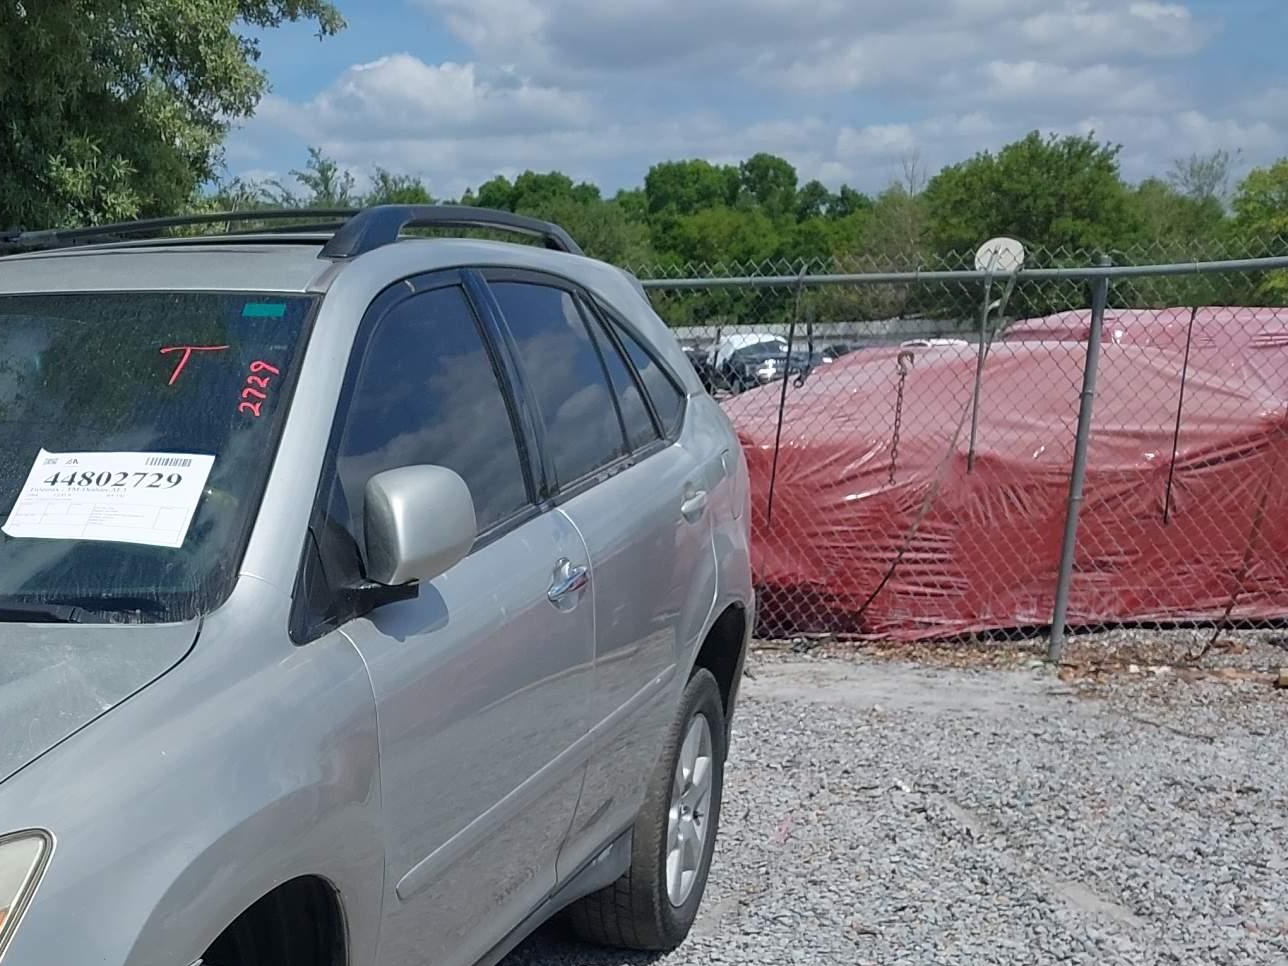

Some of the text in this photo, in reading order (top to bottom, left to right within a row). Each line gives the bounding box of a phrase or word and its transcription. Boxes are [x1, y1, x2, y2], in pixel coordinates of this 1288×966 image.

[160, 344, 230, 385] T
[239, 359, 280, 416] 2729
[43, 470, 183, 489] 44802729
